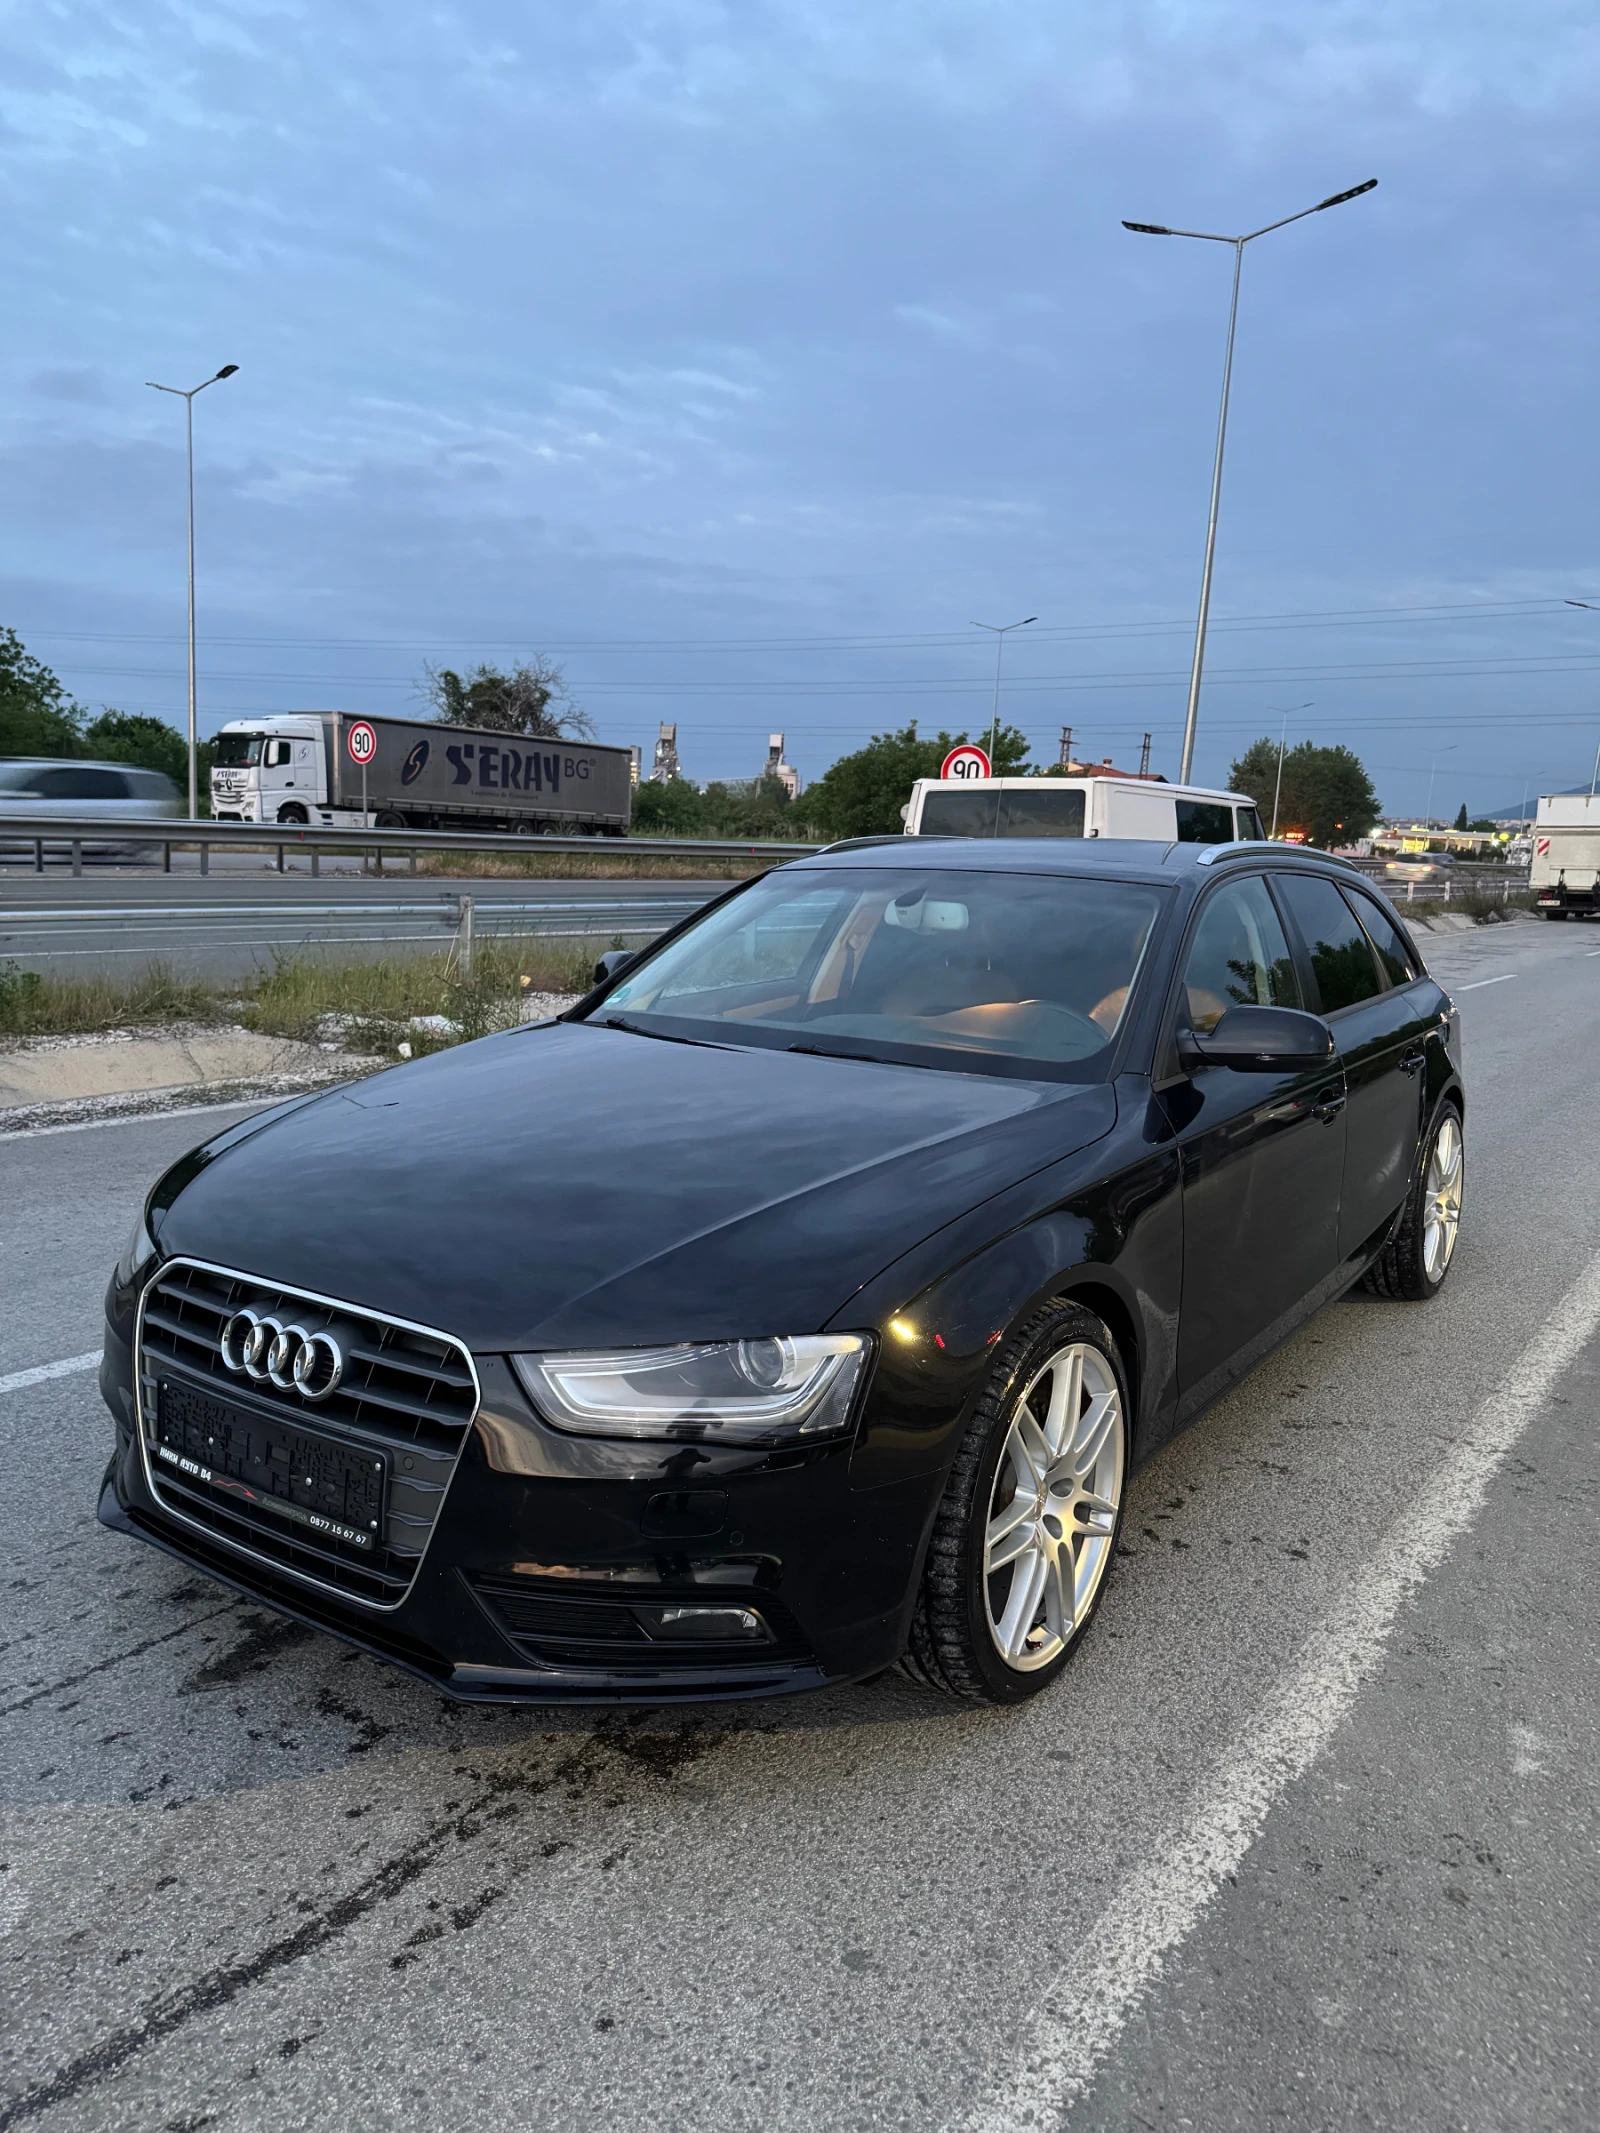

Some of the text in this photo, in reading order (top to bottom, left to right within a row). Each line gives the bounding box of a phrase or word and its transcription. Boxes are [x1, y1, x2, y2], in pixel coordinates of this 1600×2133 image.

[354, 733, 370, 753] 90
[446, 744, 560, 792] SERAY
[953, 760, 980, 779] 90
[310, 1516, 330, 1530] 0877
[331, 1524, 342, 1535] 15
[343, 1529, 354, 1540] 67
[355, 1534, 367, 1545] 67
